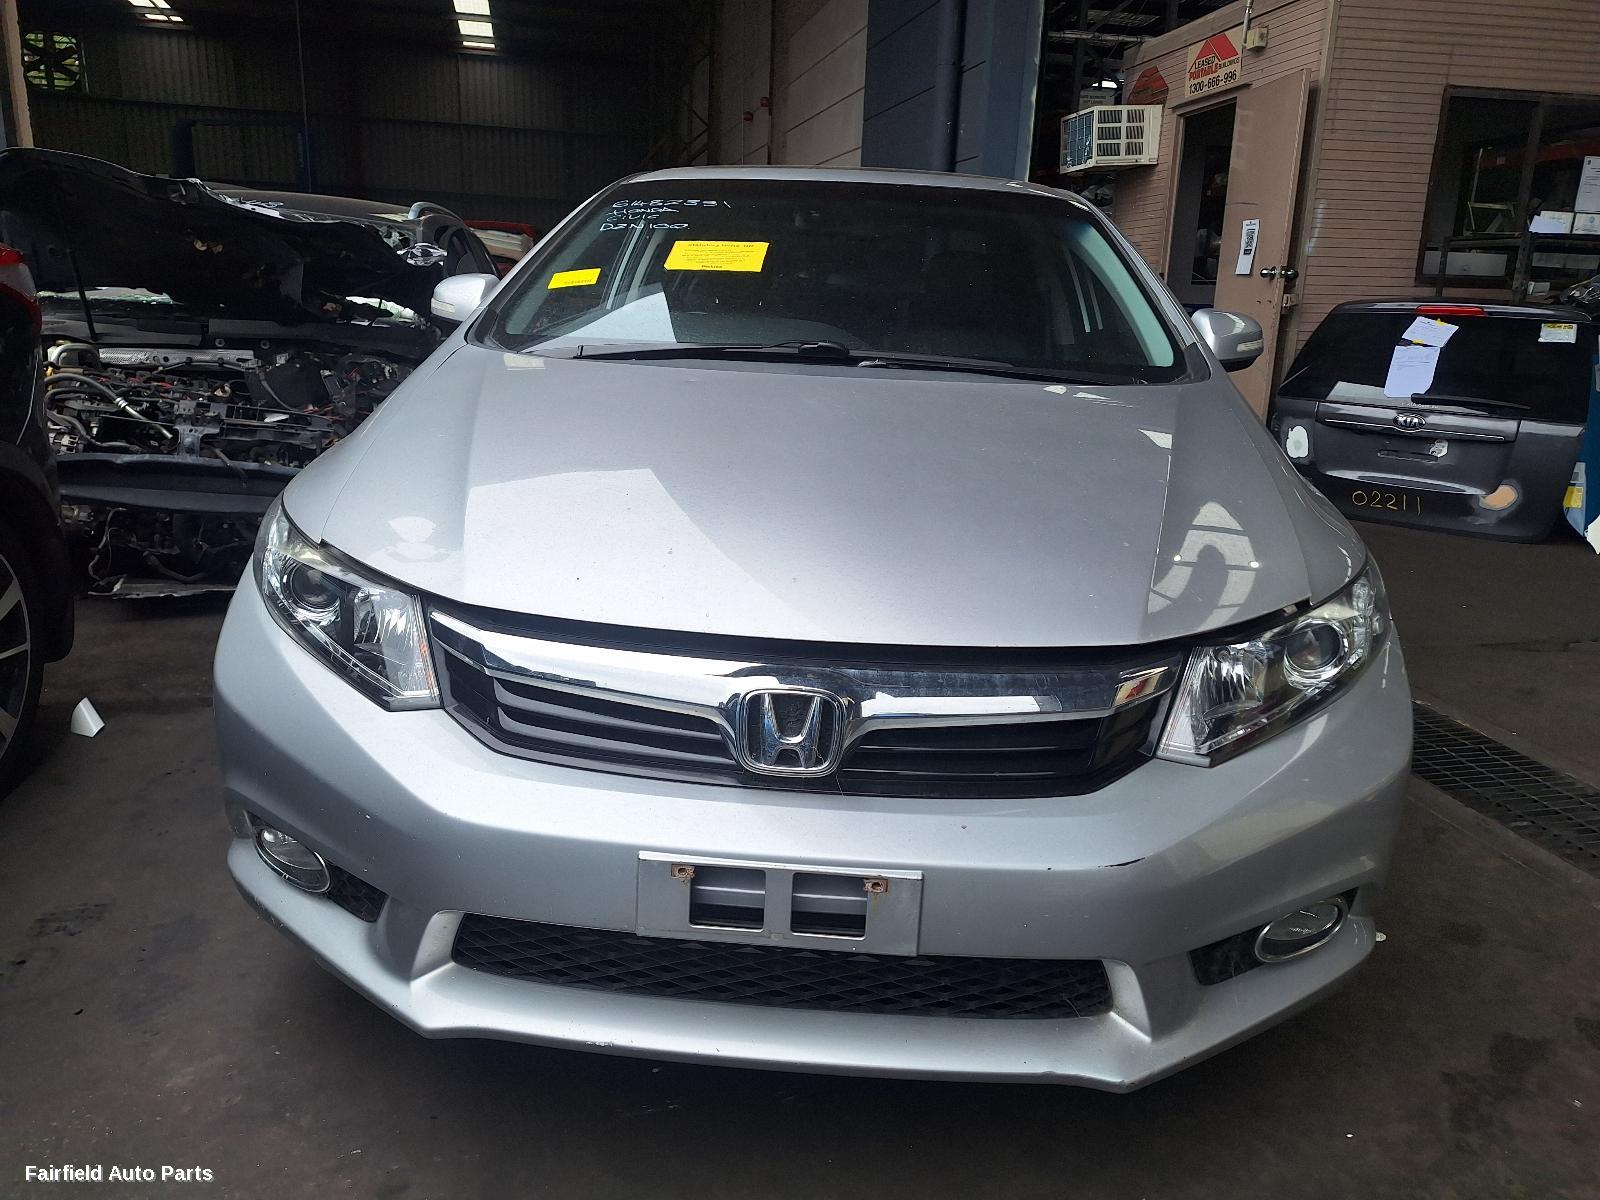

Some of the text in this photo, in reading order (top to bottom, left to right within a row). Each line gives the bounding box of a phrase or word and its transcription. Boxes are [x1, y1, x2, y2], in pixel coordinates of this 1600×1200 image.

[1194, 56, 1216, 69] LEASED
[1189, 69, 1237, 95] 1300-666-996
[1352, 490, 1422, 516] 02211
